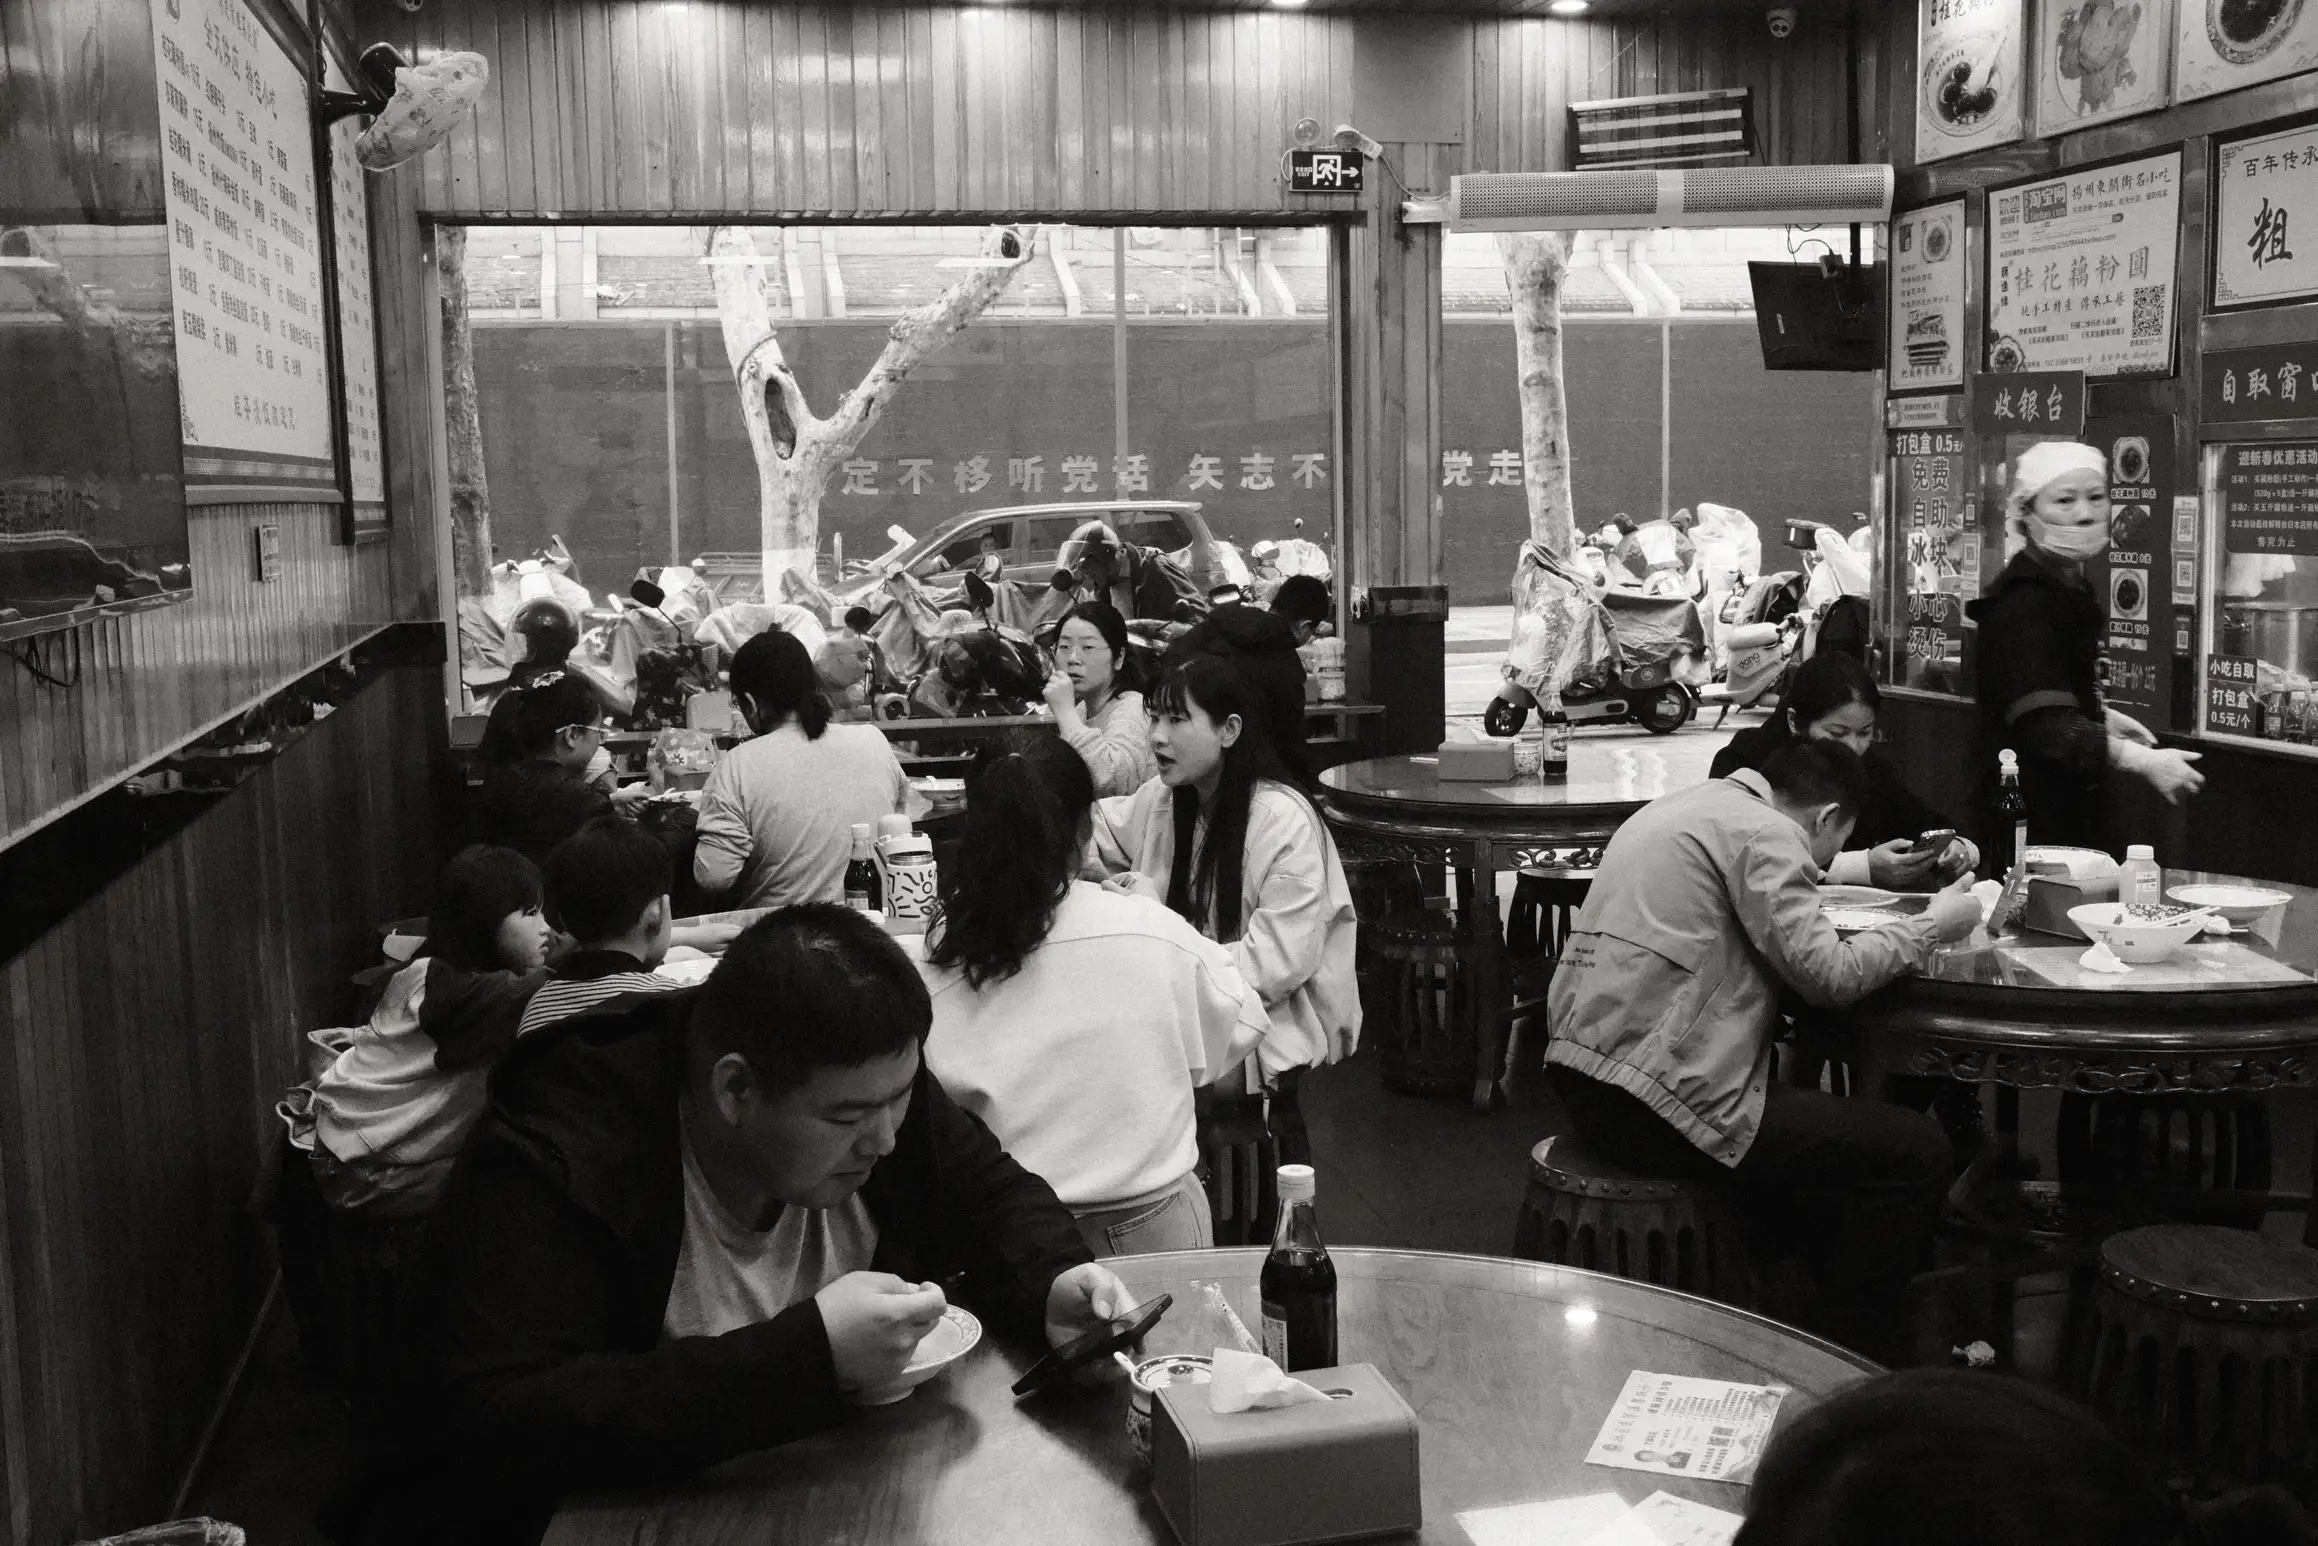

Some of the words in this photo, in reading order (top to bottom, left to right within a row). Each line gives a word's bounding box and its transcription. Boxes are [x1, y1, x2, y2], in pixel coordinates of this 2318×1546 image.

[204, 12, 240, 81] 全天供应
[246, 60, 277, 120] 特色小吃
[2243, 145, 2318, 178] 百年传承
[2247, 197, 2294, 271] 粗
[1994, 384, 2064, 423] 收银台
[1896, 432, 1931, 455] 打包盒
[2239, 449, 2318, 466] 迎新春优惠活动
[842, 454, 1149, 496] 定不移听党话
[1188, 452, 1327, 492] 矢志不
[1442, 449, 1522, 487] 党走
[1911, 456, 1949, 490] 免费
[1913, 497, 1948, 529] 自助
[1911, 536, 1947, 567] 冰块
[1909, 589, 1948, 622] 小心
[1909, 626, 1947, 660] 烫伤
[2210, 659, 2254, 679] 小吃自取
[2212, 687, 2249, 709] 打包盒
[2211, 711, 2250, 729] 0.5元/个
